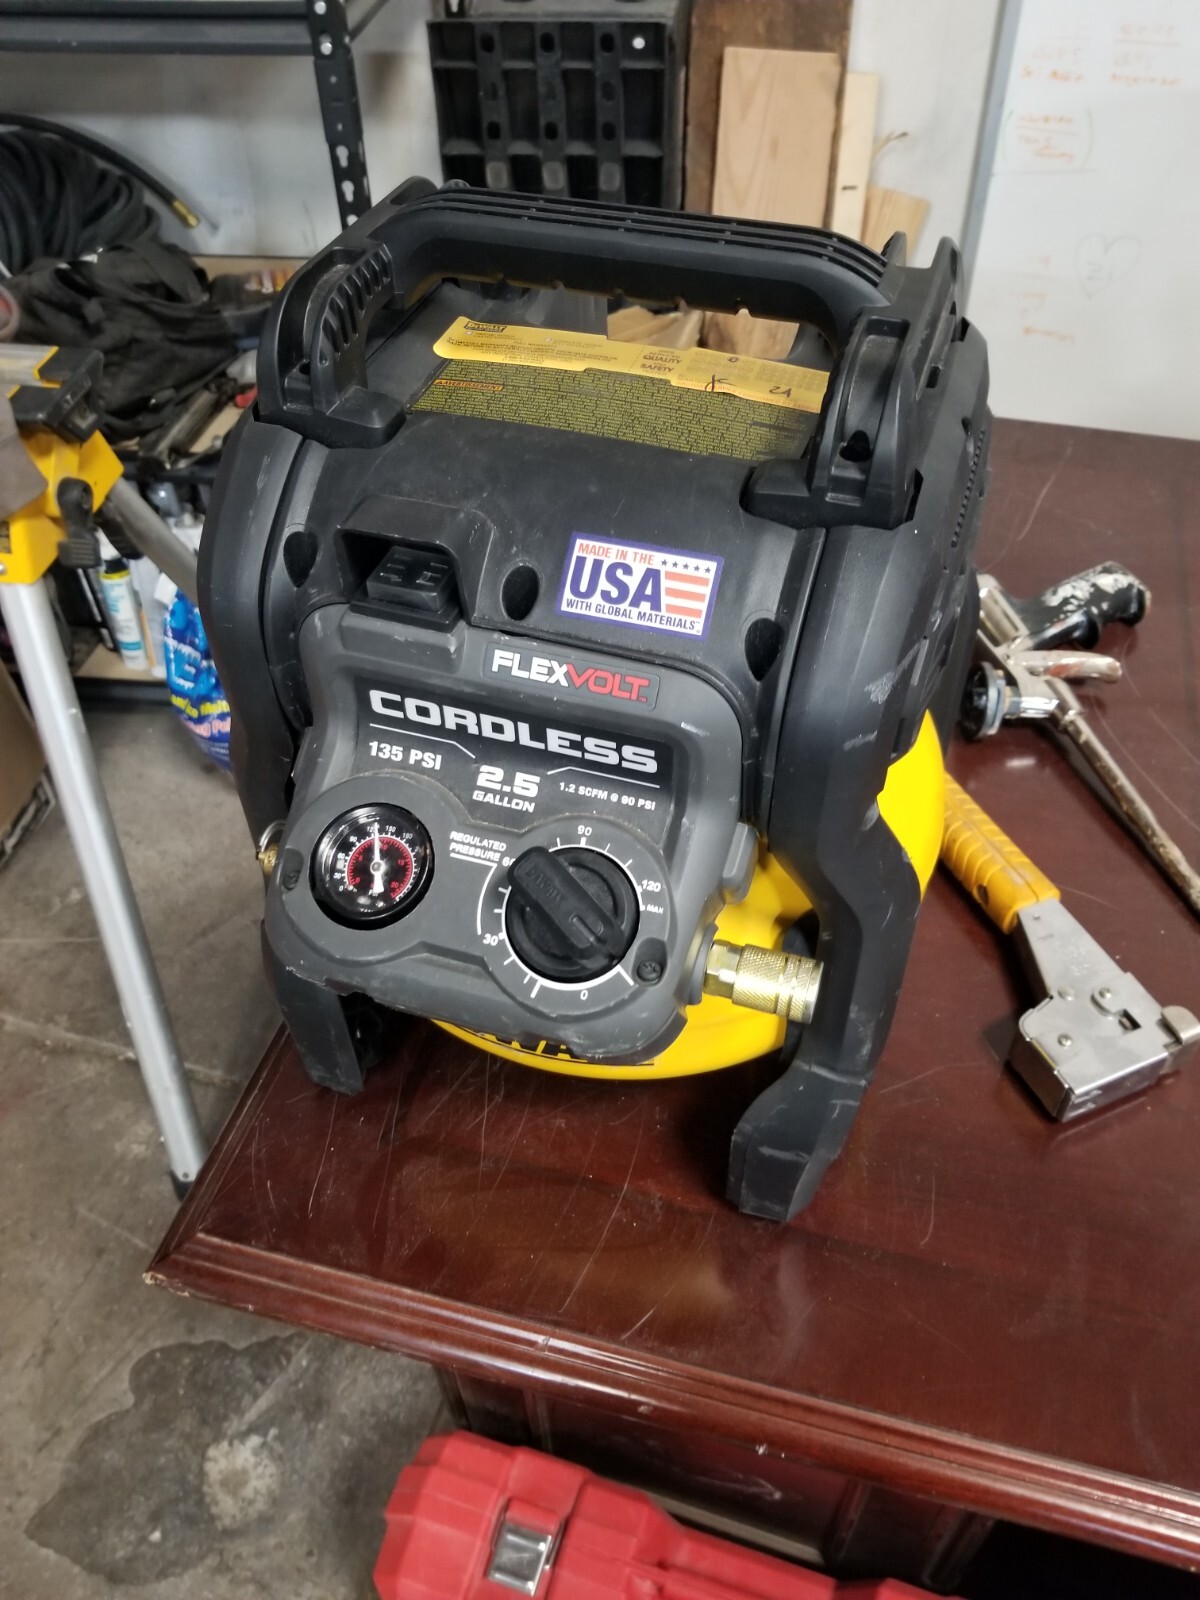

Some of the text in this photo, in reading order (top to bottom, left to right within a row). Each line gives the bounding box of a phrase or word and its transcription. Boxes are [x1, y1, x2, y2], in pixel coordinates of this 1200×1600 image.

[578, 543, 656, 566] MADE IN THE
[569, 555, 662, 613] USA
[566, 598, 696, 631] WITH GLOBAL MATERIALS
[491, 649, 650, 702] FLEXVOLT
[369, 689, 658, 774] CORDLESS
[369, 740, 442, 770] 135 PSI
[476, 764, 541, 798] 2.5
[472, 789, 536, 813] GALLON
[559, 781, 656, 811] 1.2 SCFM @ 90 PSI
[385, 825, 397, 833] 150
[577, 824, 593, 837] 90
[449, 842, 501, 862] PRESSURE
[450, 831, 507, 852] REGULATED
[641, 879, 661, 893] 120
[646, 904, 664, 914] MAX
[482, 932, 499, 947] 30
[579, 989, 589, 1001] 0
